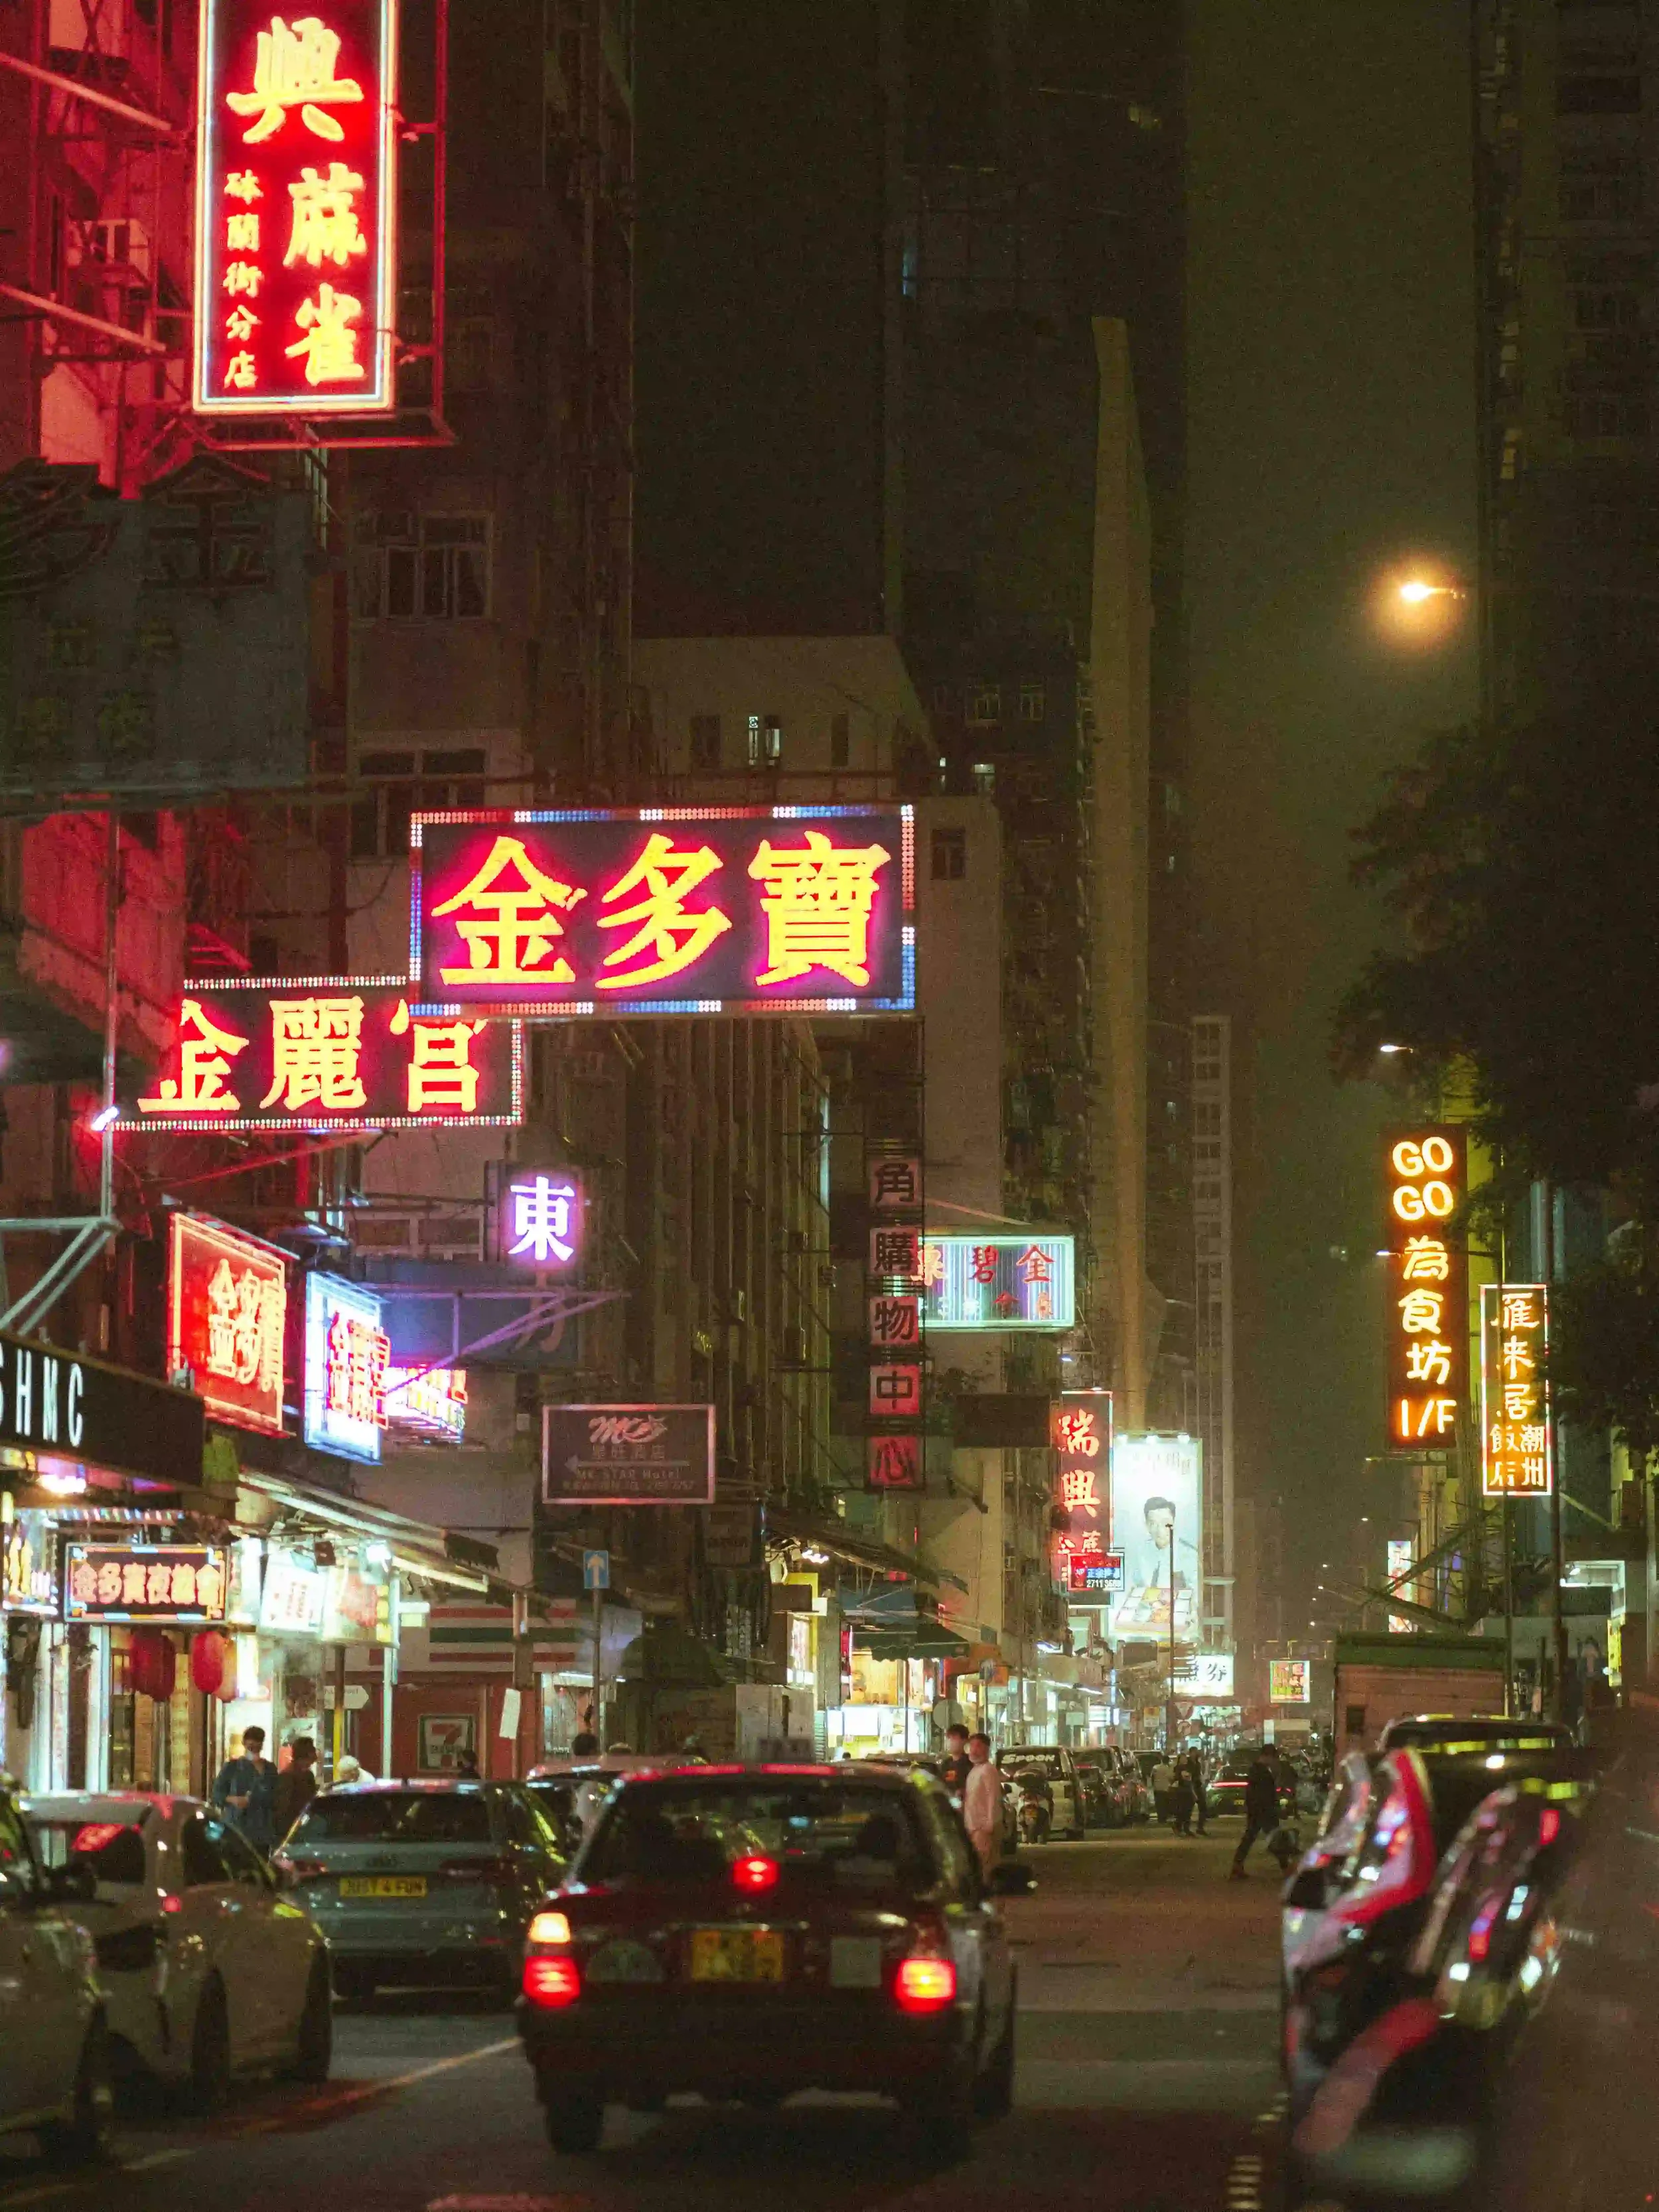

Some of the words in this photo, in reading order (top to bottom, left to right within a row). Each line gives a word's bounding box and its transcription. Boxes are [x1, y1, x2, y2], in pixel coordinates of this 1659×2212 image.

[431, 830, 892, 989] 金多寶
[137, 995, 490, 1113] 金麗宮
[1392, 1136, 1454, 1177] GO
[1393, 1180, 1455, 1221] GO
[1398, 1234, 1453, 1385] 為食坊
